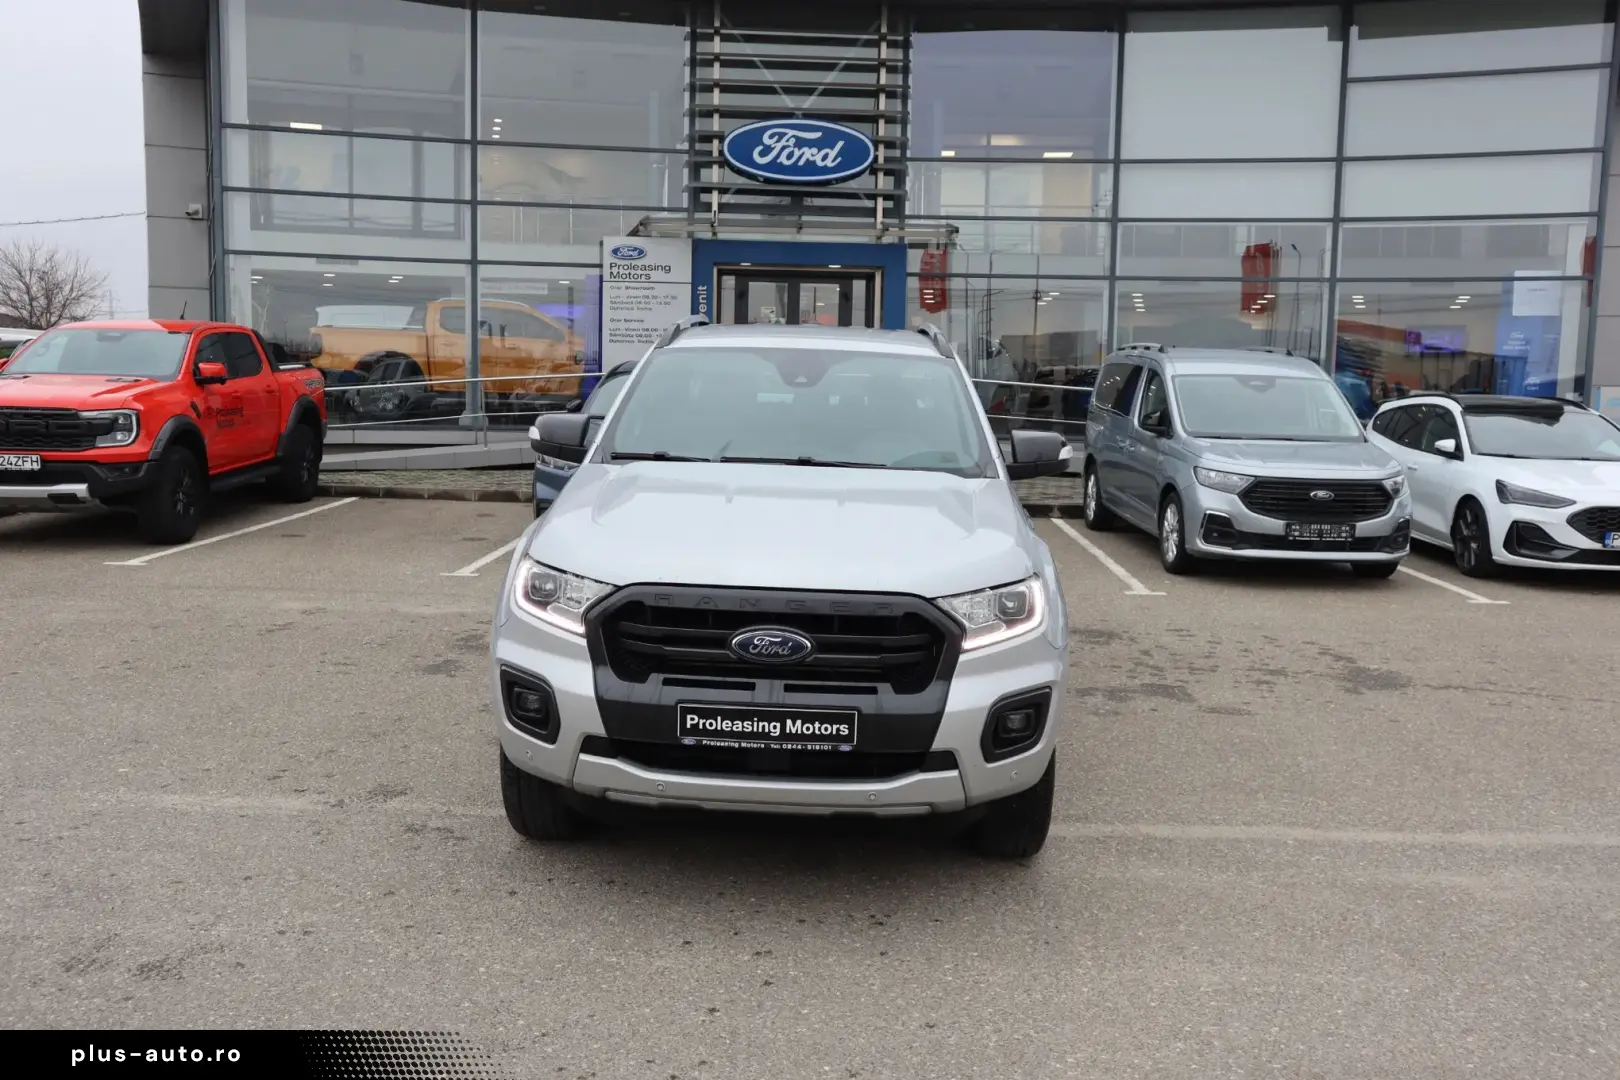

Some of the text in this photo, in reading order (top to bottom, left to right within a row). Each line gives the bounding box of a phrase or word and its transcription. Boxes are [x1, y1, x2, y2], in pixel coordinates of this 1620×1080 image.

[752, 127, 845, 169] Ford
[609, 262, 671, 274] Proleasing
[609, 271, 651, 280] Motors
[697, 285, 707, 316] enit
[0, 456, 39, 467] 24ZFH
[654, 593, 894, 614] RANGER
[749, 635, 792, 656] Ford
[686, 714, 849, 737] Proleasing Motors
[702, 740, 739, 748] Proleasing
